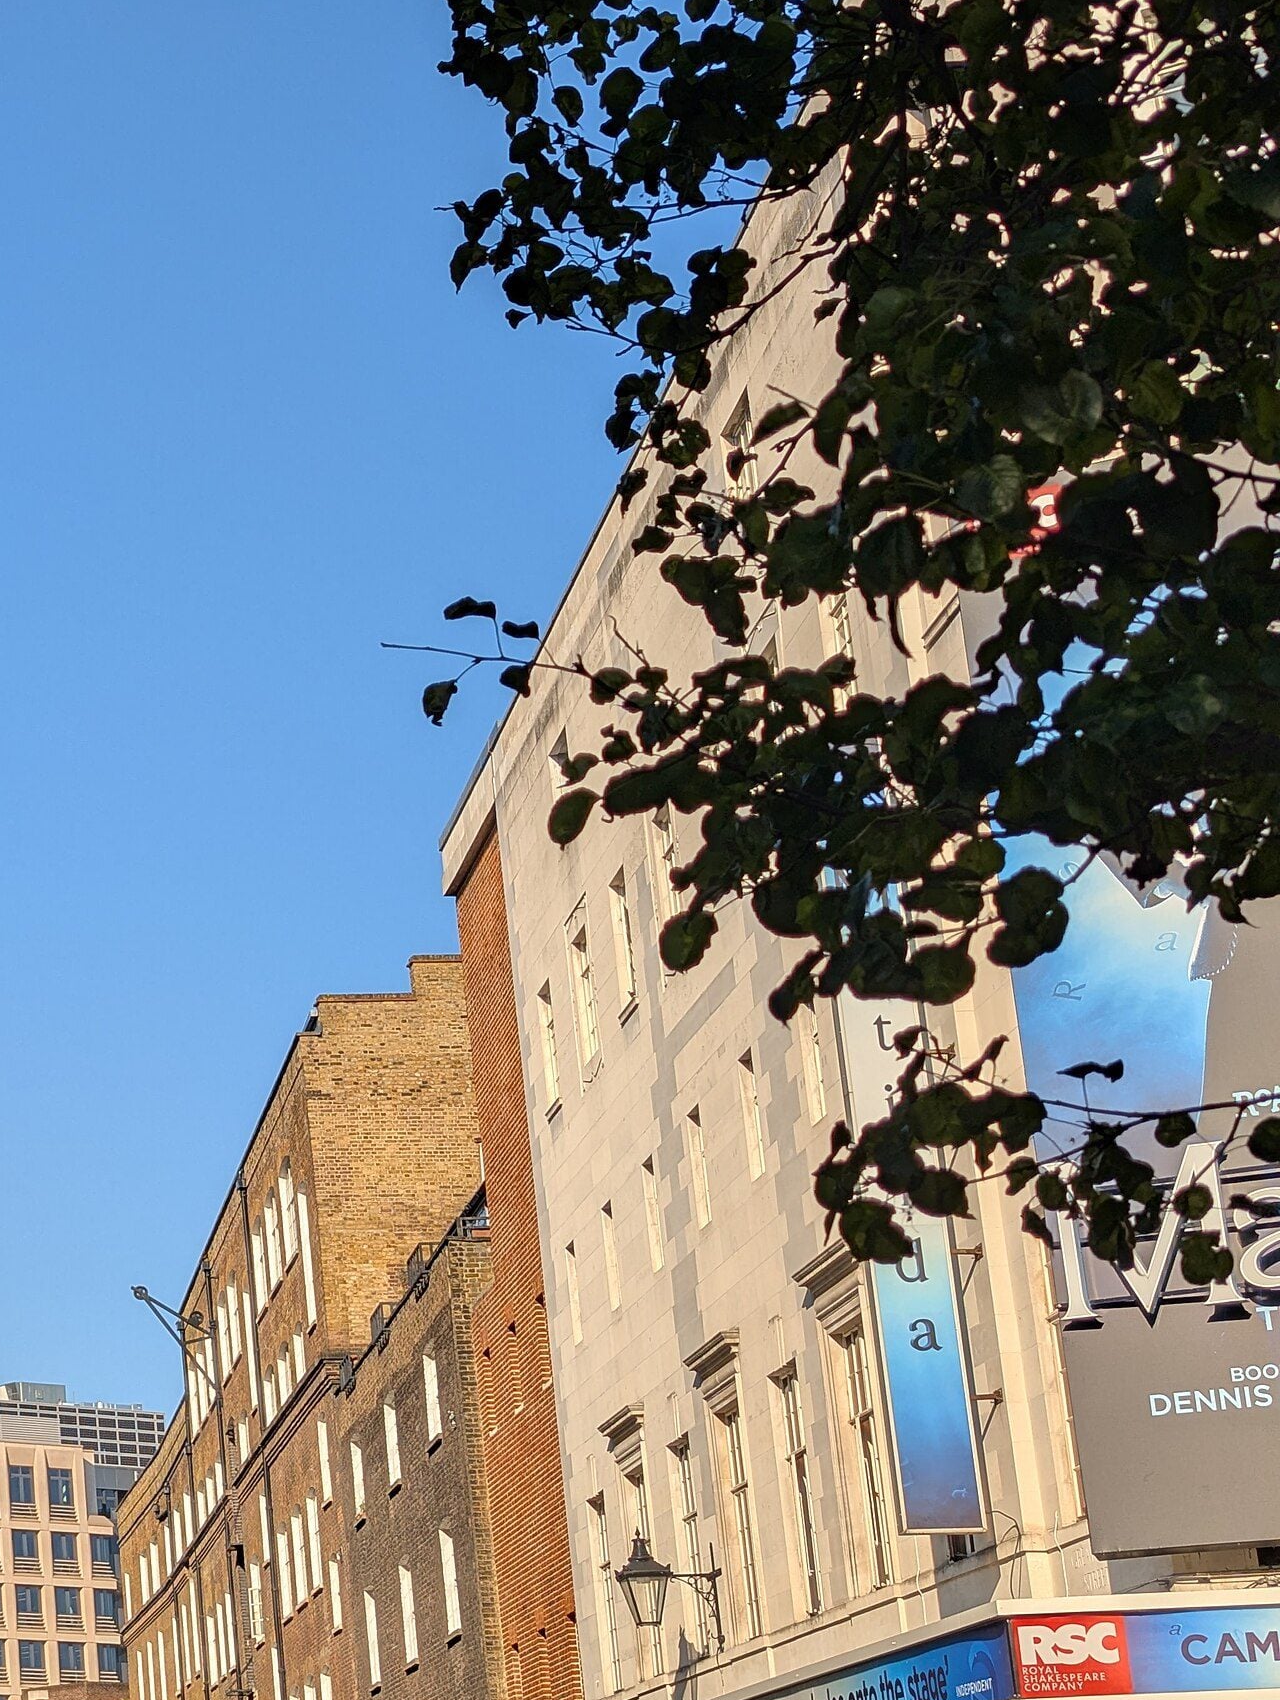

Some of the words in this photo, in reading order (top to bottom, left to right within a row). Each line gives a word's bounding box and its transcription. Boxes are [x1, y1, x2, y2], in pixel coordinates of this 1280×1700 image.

[1148, 1384, 1273, 1417] DENNIS
[1017, 1621, 1121, 1666] RSC
[1181, 1630, 1280, 1666] CAM
[1022, 1665, 1059, 1676] ROYAL
[1023, 1672, 1106, 1683] SHAKESPEARE
[955, 1677, 993, 1698] INDEPENDENT
[1024, 1681, 1084, 1692] COMPANY
